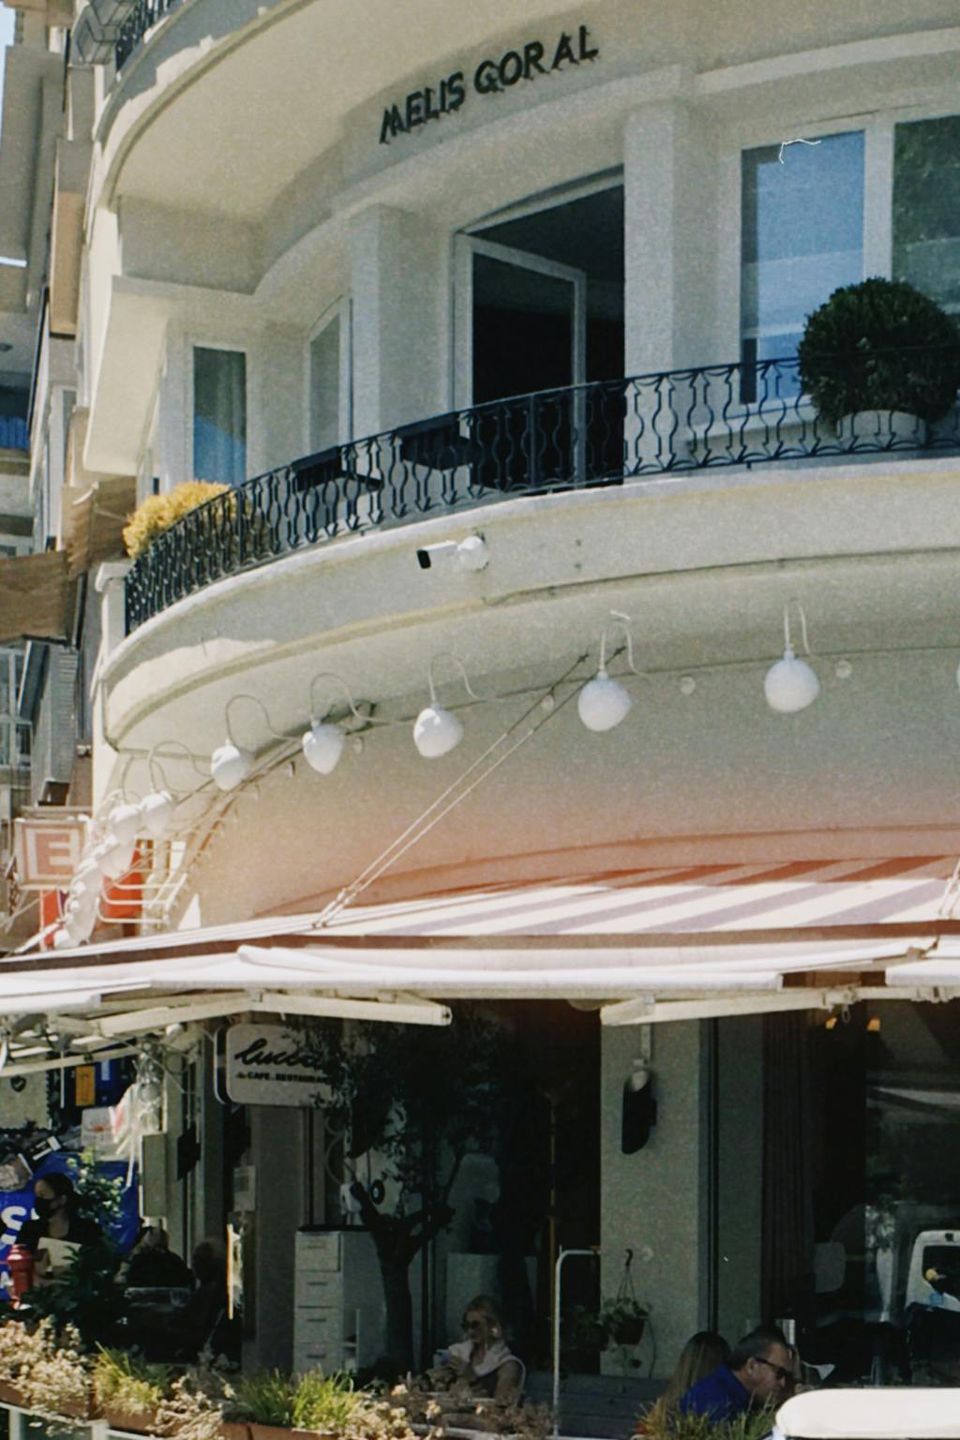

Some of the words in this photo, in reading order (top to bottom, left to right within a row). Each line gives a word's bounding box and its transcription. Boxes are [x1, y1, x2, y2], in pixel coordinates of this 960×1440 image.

[379, 71, 467, 145] MELIS
[473, 24, 600, 95] GORAL
[36, 832, 75, 875] E
